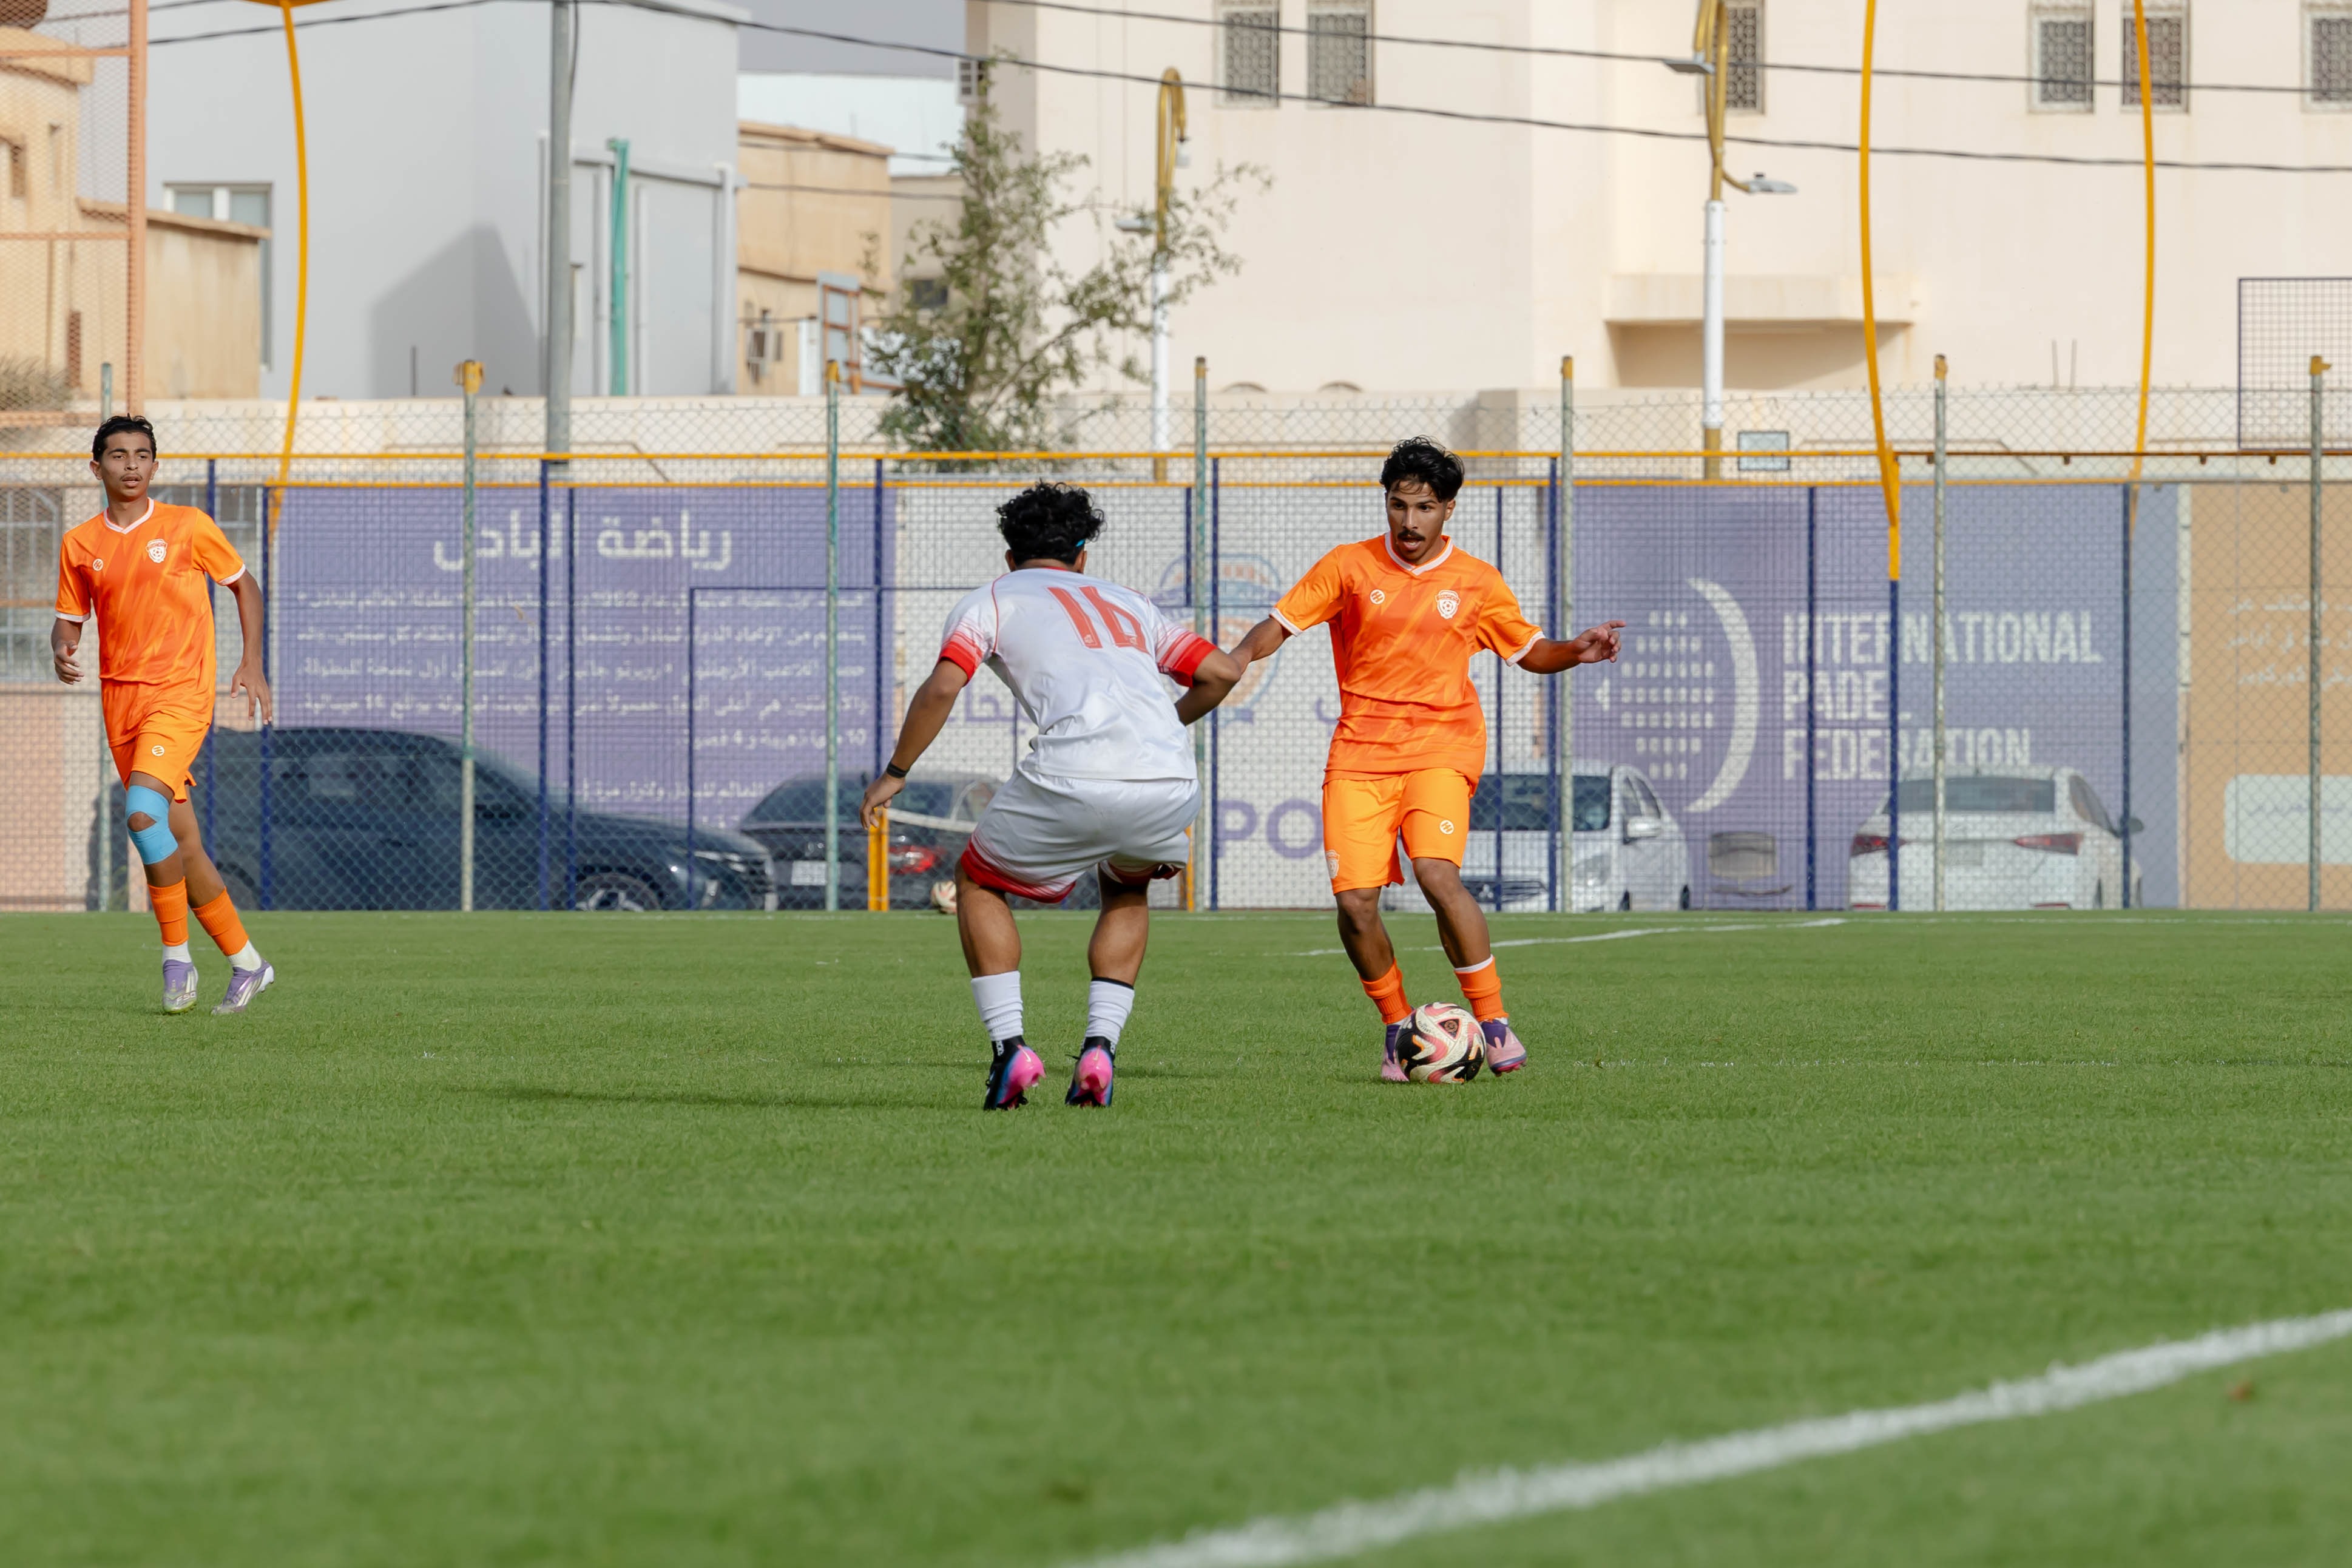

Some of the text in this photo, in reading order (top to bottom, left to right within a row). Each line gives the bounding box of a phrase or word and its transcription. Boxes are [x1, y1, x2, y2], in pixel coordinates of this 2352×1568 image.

[597, 509, 732, 571] رياضة
[1045, 584, 1153, 657] 16
[1782, 671, 1911, 720] PADE
